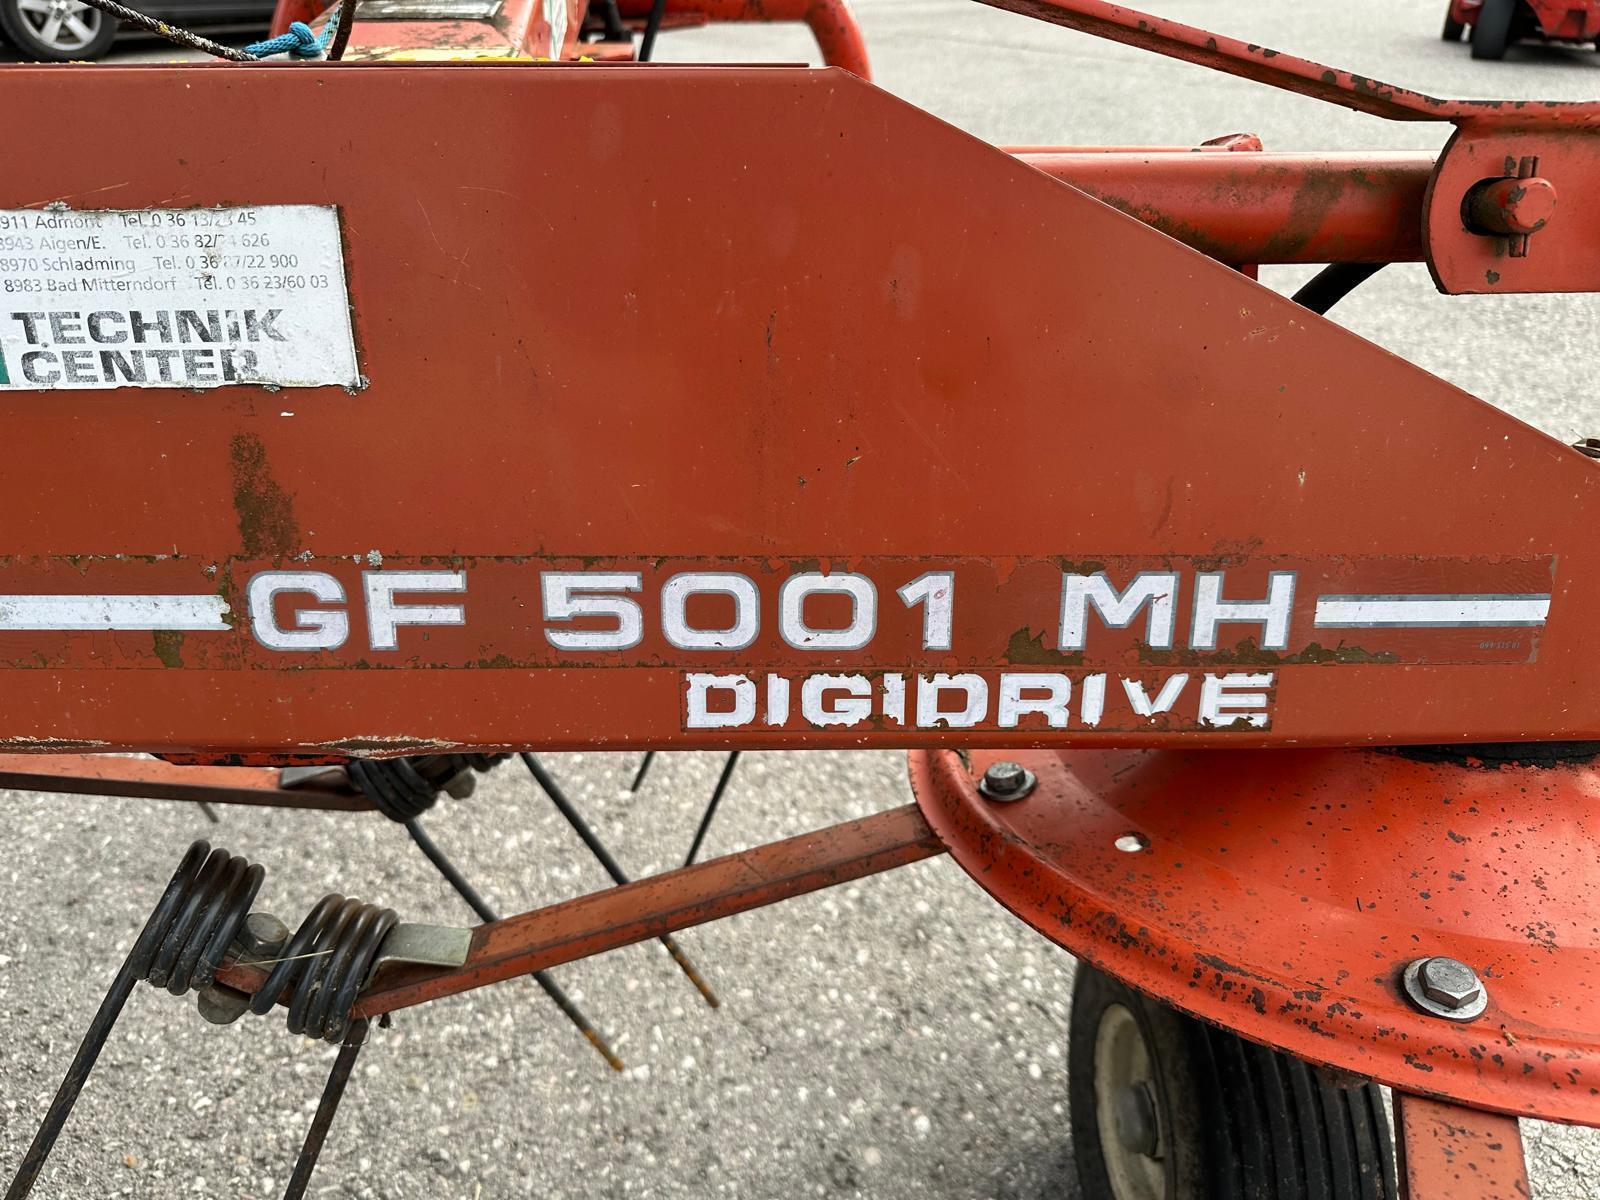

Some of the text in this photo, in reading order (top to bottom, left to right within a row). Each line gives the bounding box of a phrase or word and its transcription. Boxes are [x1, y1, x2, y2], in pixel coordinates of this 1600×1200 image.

[0, 215, 28, 230] 911
[119, 213, 147, 229] Tel.
[166, 213, 186, 228] 36
[238, 211, 256, 227] 45
[40, 236, 106, 254] Aigen/E.
[122, 235, 151, 250] Tel.
[156, 235, 166, 249] 0
[171, 234, 190, 249] 36
[242, 233, 270, 248] 626
[0, 257, 38, 272] 8970
[43, 256, 135, 274] Schladming
[153, 256, 181, 270] Tel.
[186, 255, 195, 270] 0
[200, 255, 219, 270] 36
[270, 254, 299, 269] 900
[4, 275, 329, 293] 8983 Bad Mitterndorf Tel. 0 36 23/60 03
[10, 308, 288, 345] TECHNIK
[20, 348, 259, 384] CENTER
[247, 570, 1297, 651] GF 5001 MH
[686, 672, 1274, 729] DIGIDRIVE
